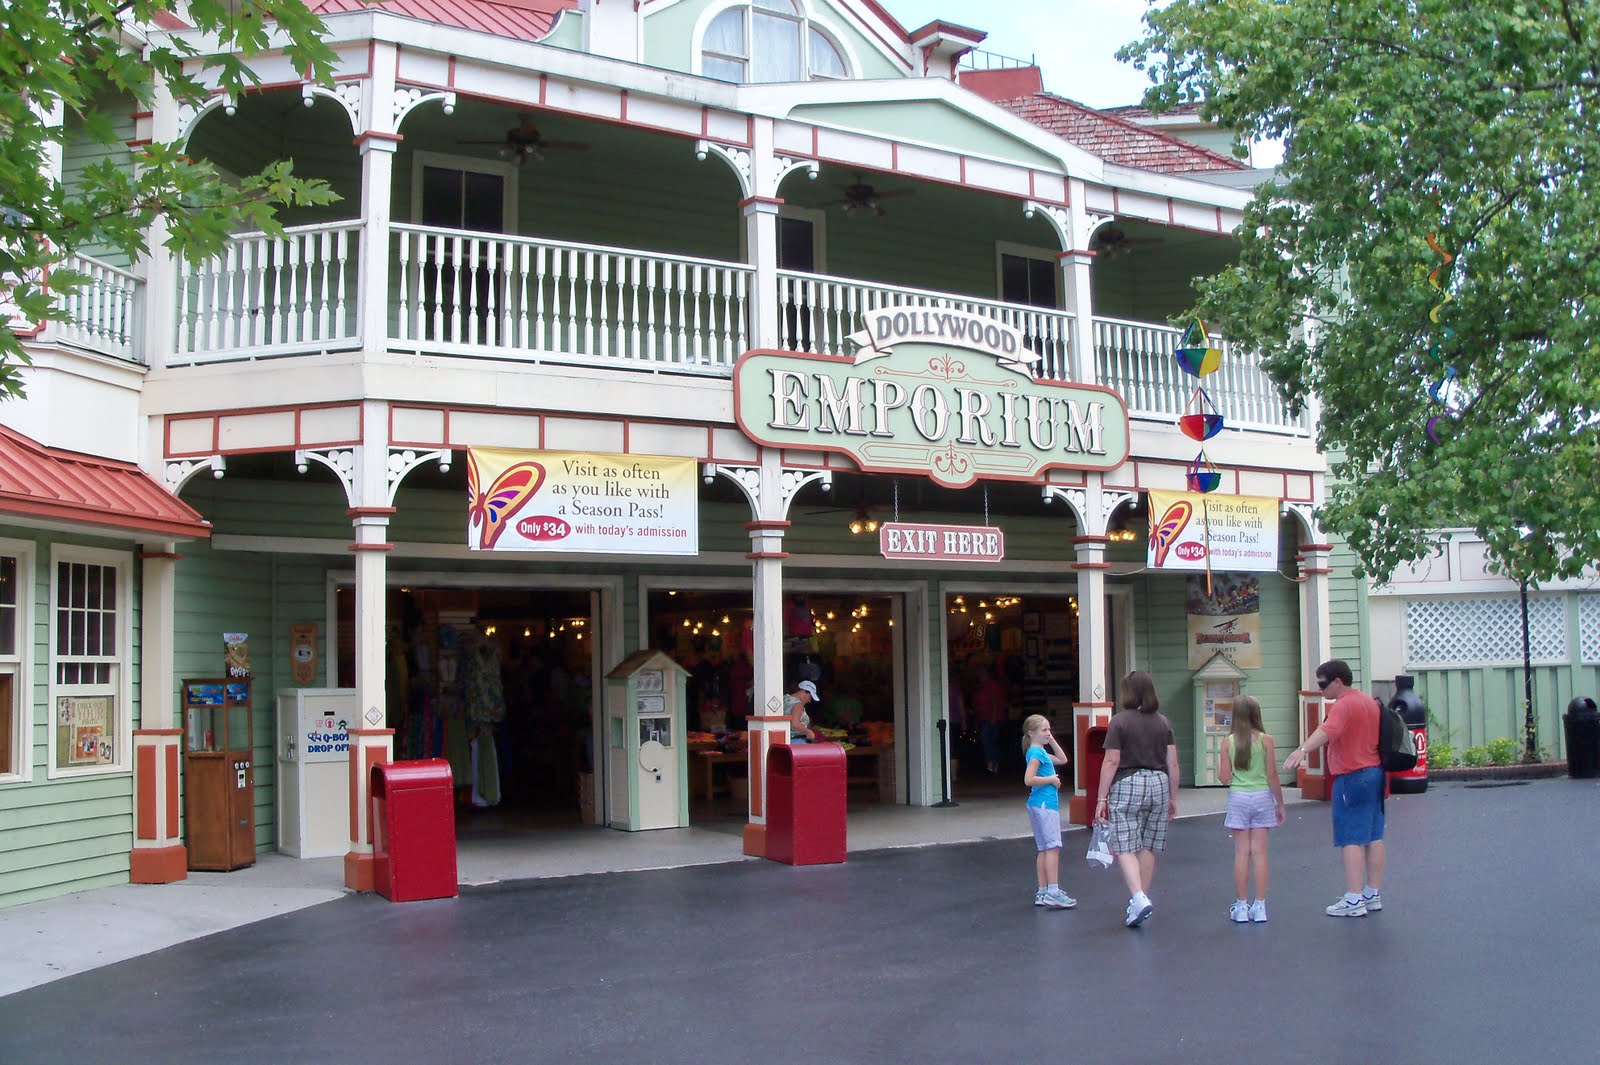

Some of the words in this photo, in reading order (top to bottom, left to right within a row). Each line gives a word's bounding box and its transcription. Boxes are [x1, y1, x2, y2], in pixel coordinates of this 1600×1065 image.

[876, 312, 1017, 355] DOLLYWOOD
[766, 368, 1107, 456] EMPORIUM
[562, 459, 598, 477] Visit
[602, 467, 618, 478] as
[622, 463, 661, 480] often
[552, 484, 567, 495] as
[571, 484, 600, 502] you
[605, 481, 632, 498] like
[637, 484, 670, 499] with
[558, 505, 566, 515] a
[572, 500, 622, 517] Season
[629, 502, 664, 519] Pass!
[1225, 505, 1234, 513] as
[1236, 501, 1258, 514] often
[520, 522, 541, 536] Only
[543, 522, 566, 537] $34
[575, 524, 596, 535] with
[598, 525, 634, 538] today's
[637, 526, 687, 538] admission
[1195, 517, 1205, 526] as
[1207, 518, 1224, 530] you
[1226, 515, 1242, 527] like
[1244, 517, 1263, 529] with
[887, 529, 938, 554] EXIT
[943, 531, 999, 556] HERE
[1199, 533, 1204, 541] a
[1207, 529, 1236, 542] Season
[1239, 531, 1259, 544] Pass!
[1178, 547, 1190, 557] Only
[1191, 546, 1205, 557] $34
[1209, 547, 1221, 556] with
[1222, 548, 1242, 558] today's
[1243, 549, 1272, 558] admission
[307, 744, 334, 753] DROP
